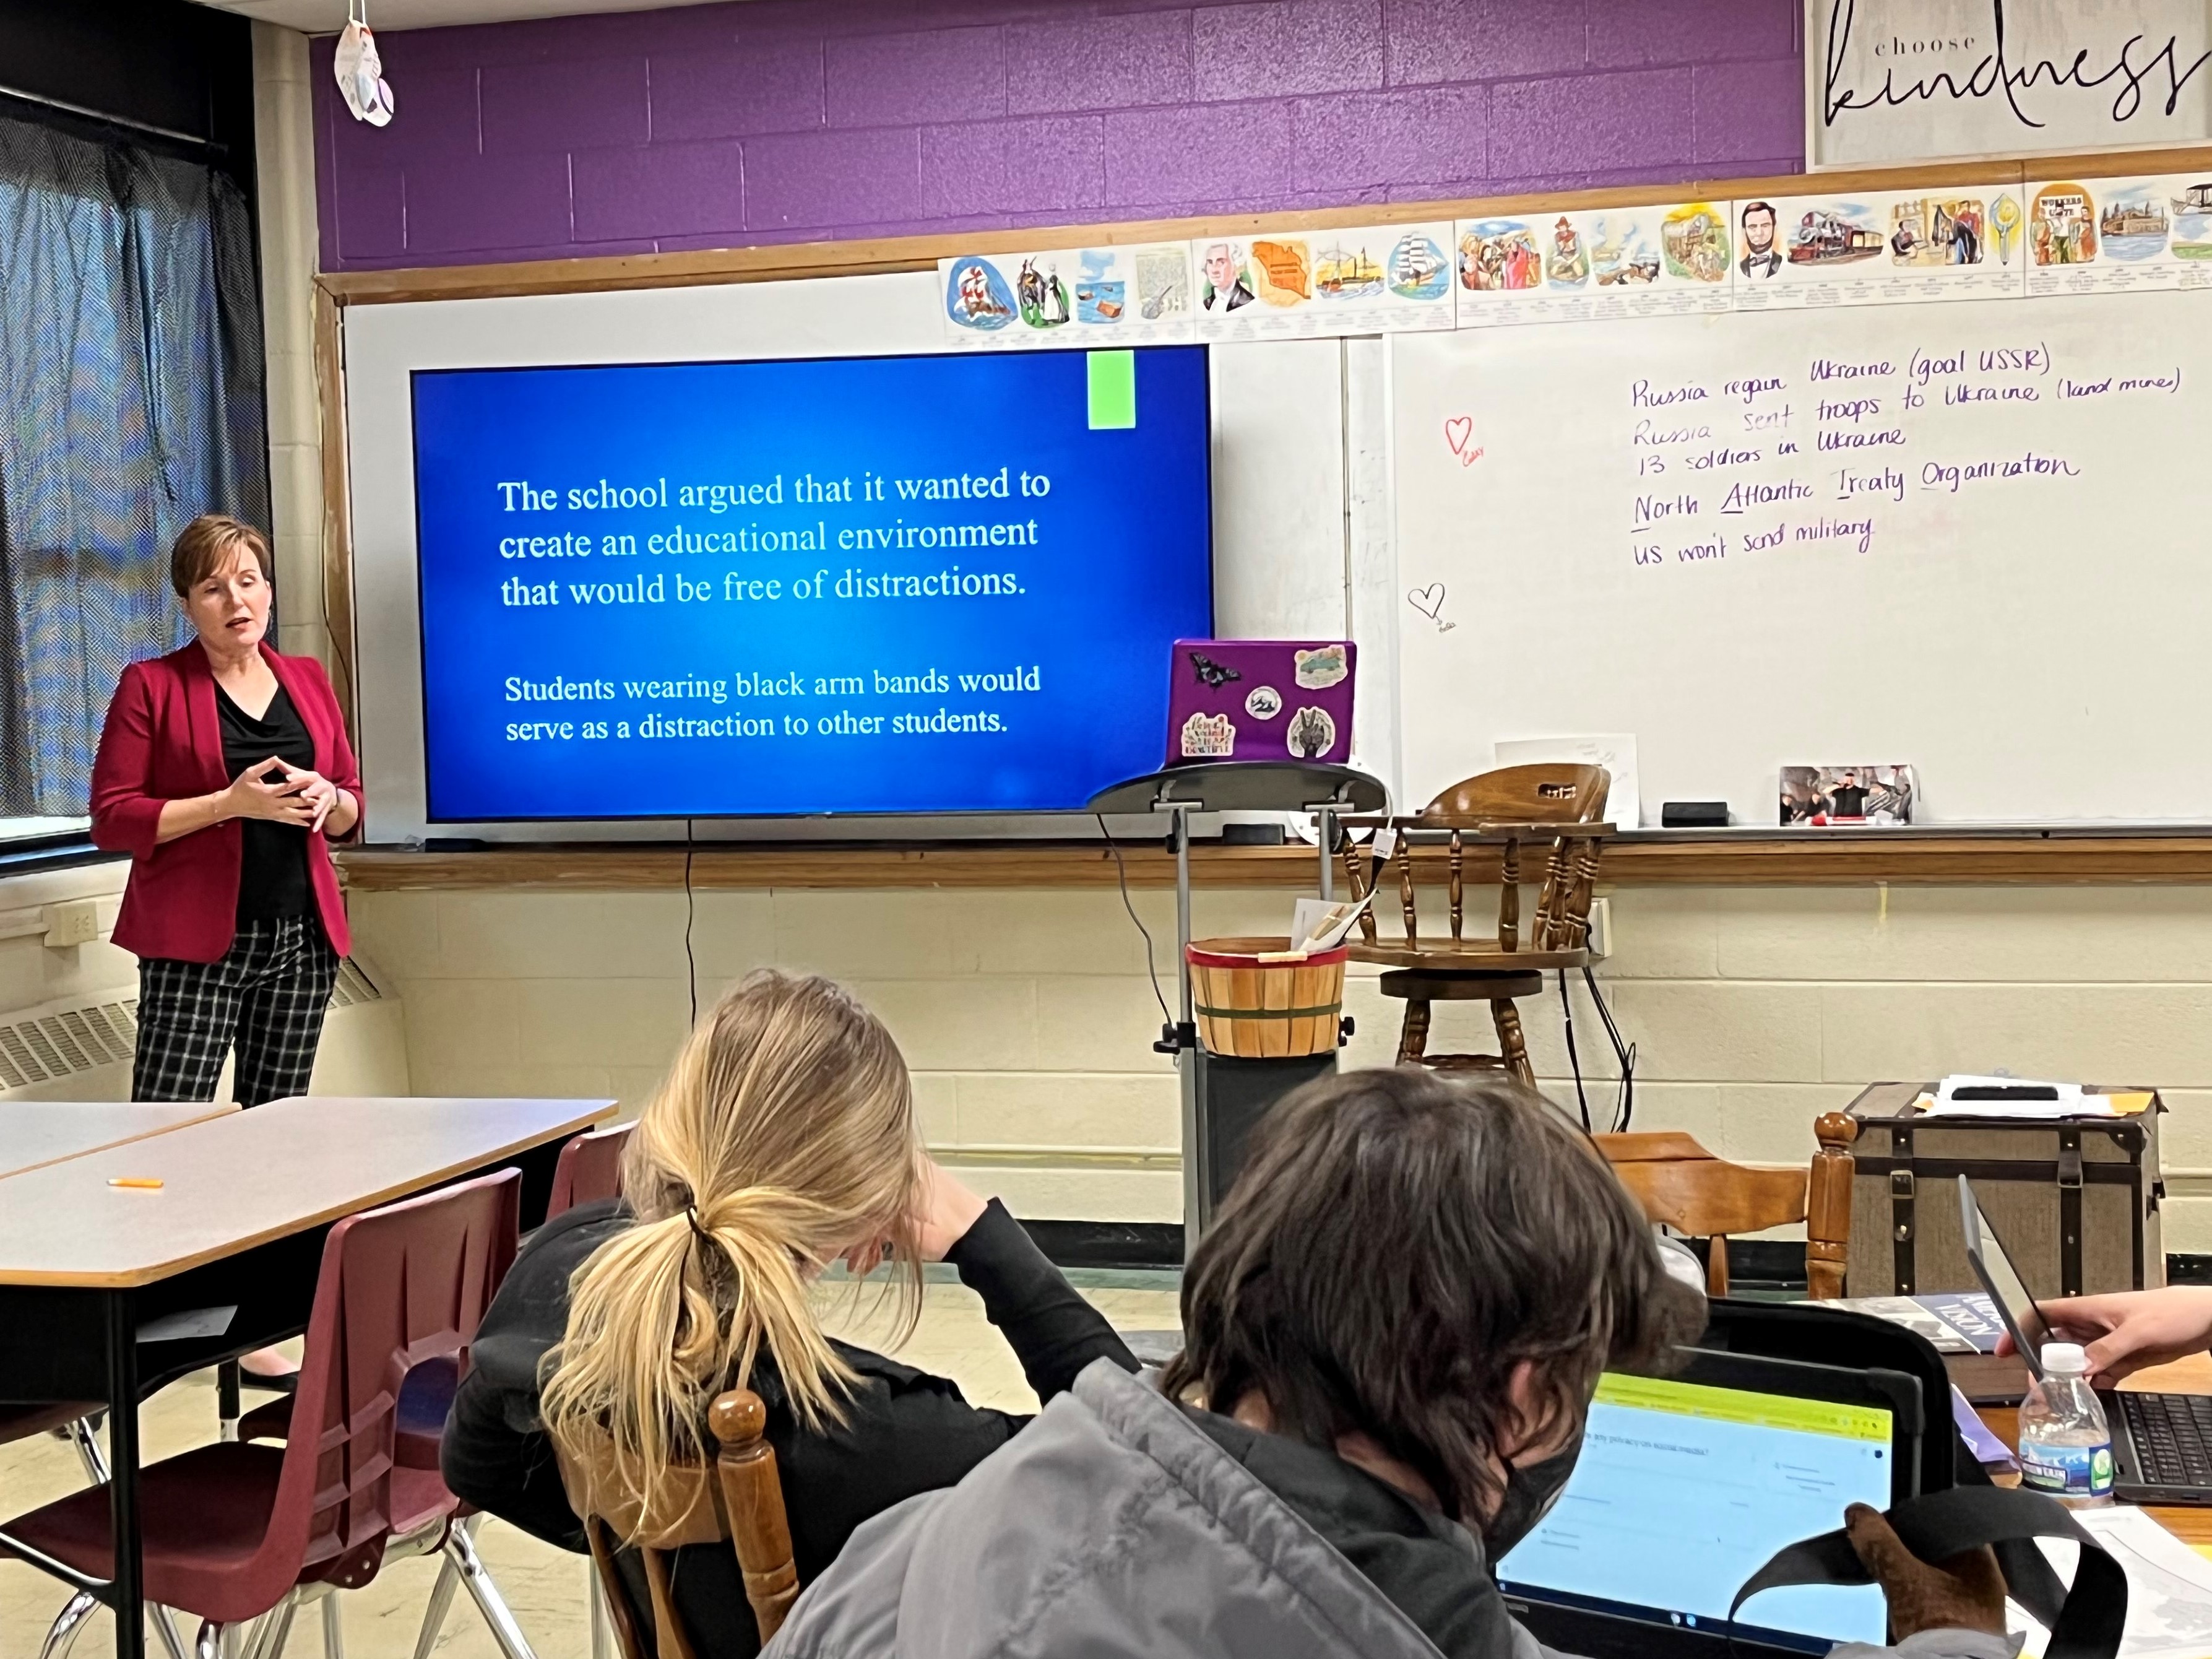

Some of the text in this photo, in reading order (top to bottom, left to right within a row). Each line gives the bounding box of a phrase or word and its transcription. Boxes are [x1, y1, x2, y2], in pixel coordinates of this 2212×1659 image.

[1826, 0, 2212, 127] kindness
[1875, 35, 1975, 56] choose
[1633, 379, 1709, 407] Russia
[1811, 359, 1896, 381] Ukraine
[1909, 347, 1964, 386] (goal
[1980, 341, 2049, 376] USSR)
[1634, 420, 1711, 445] Russia
[1743, 404, 1794, 431] sent
[1815, 399, 1881, 423] troops
[1902, 384, 1925, 409] to
[1945, 384, 2039, 405] Ukraine
[2057, 377, 2112, 399] (land
[1640, 455, 1665, 475] 13
[1778, 436, 1799, 454] in
[1818, 428, 1906, 451] Ukraine
[497, 467, 1050, 514] The school argued that it wanted to
[1635, 452, 2080, 524] North Atlantic Treaty Organization
[499, 519, 1039, 559] create an educational environment
[1634, 544, 1662, 566] US
[1678, 532, 1727, 562] won't
[1795, 516, 1875, 553] military
[501, 566, 1026, 607] that would be free of distractions.
[505, 665, 1041, 704] Students wearing black arm bands would
[506, 708, 1008, 741] serve as a distraction to other students.
